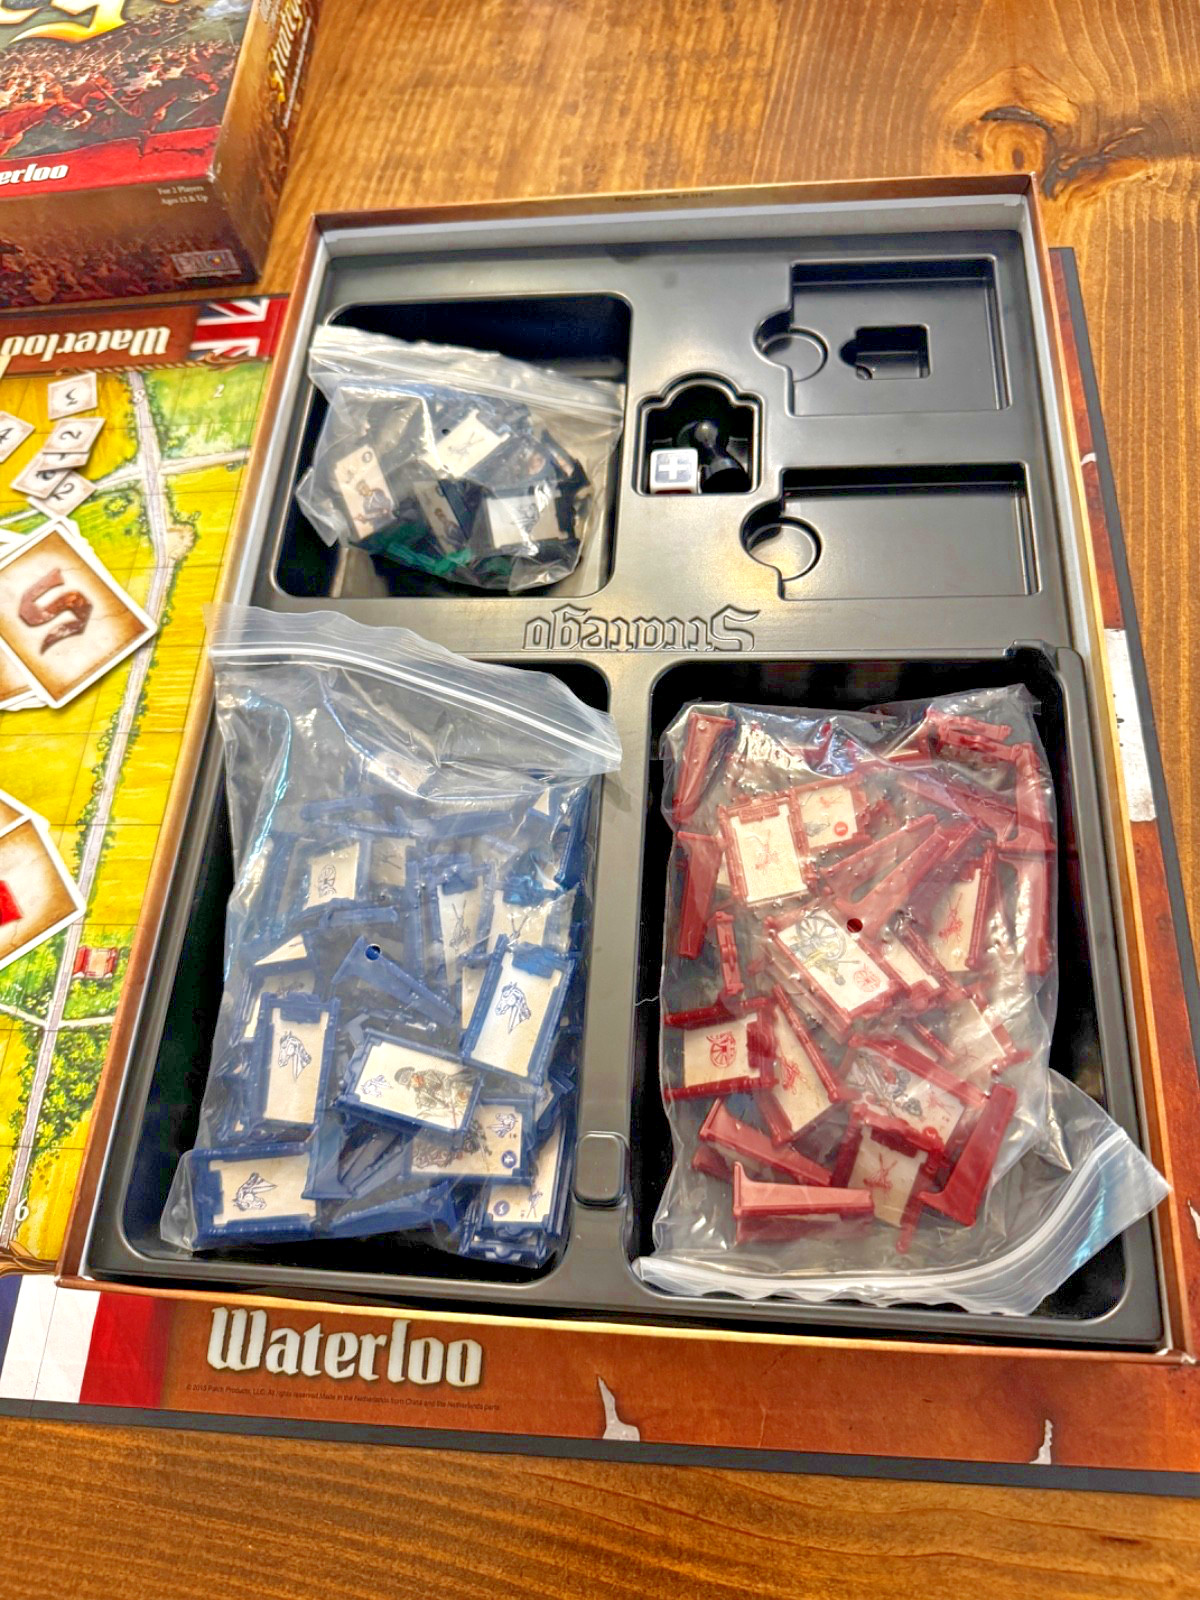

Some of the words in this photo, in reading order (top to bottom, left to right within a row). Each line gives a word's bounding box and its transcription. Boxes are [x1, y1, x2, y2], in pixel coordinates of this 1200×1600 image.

[0, 163, 69, 185] erloo
[2, 326, 171, 362] Waterloo
[522, 603, 761, 652] Stratego
[15, 1196, 30, 1222] 6
[206, 1306, 483, 1388] Waterloo
